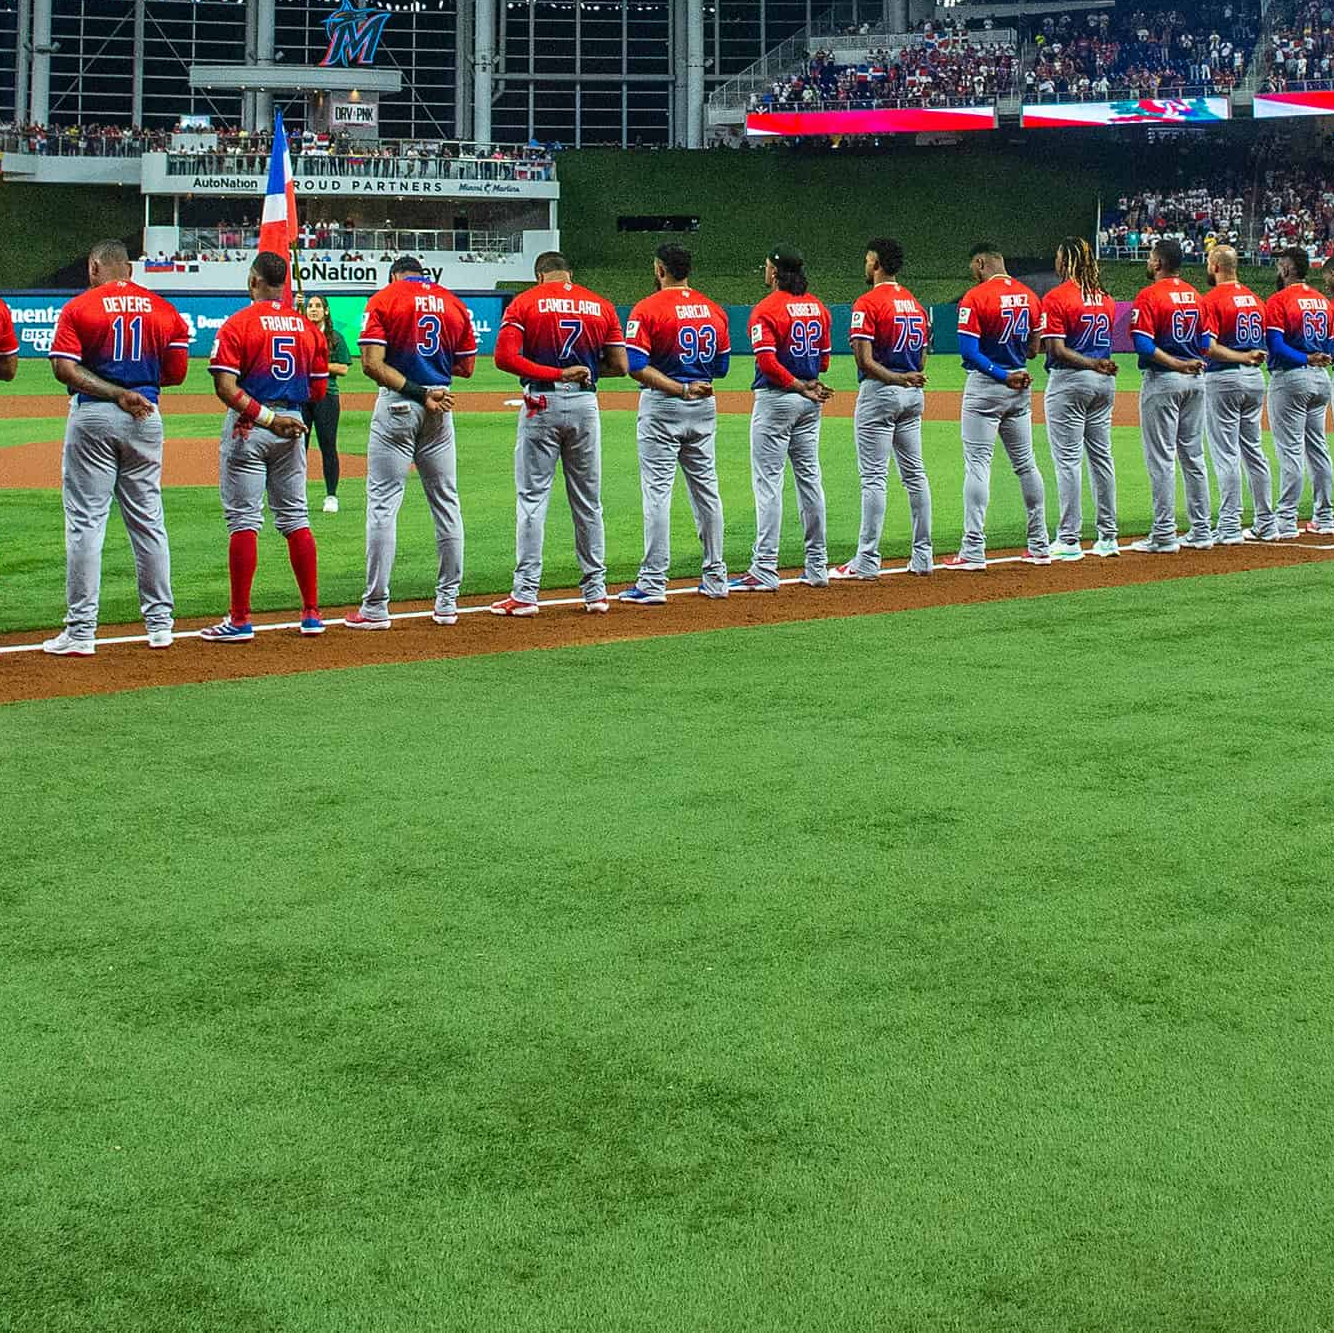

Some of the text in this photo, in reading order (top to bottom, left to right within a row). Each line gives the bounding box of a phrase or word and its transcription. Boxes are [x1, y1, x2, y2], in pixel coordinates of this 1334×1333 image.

[193, 177, 258, 188] AutoNation
[293, 180, 342, 191] ROUD
[352, 180, 443, 192] PARTNERS
[292, 263, 377, 281] toNation
[102, 296, 152, 314] DEVERS
[538, 298, 602, 317] CANDELARIO
[675, 304, 711, 319] GARCIA
[112, 315, 144, 362] 11
[259, 315, 305, 332] FRANCO
[417, 314, 442, 357] 3
[557, 319, 583, 361] 7
[789, 320, 823, 357] 92
[893, 316, 924, 353] 75
[998, 308, 1030, 345] 74
[1075, 314, 1110, 348] 72
[1172, 309, 1199, 343] 67
[1235, 311, 1262, 344] 66
[1302, 310, 1328, 341] 63
[271, 336, 296, 381] 5
[678, 324, 717, 365] 93
